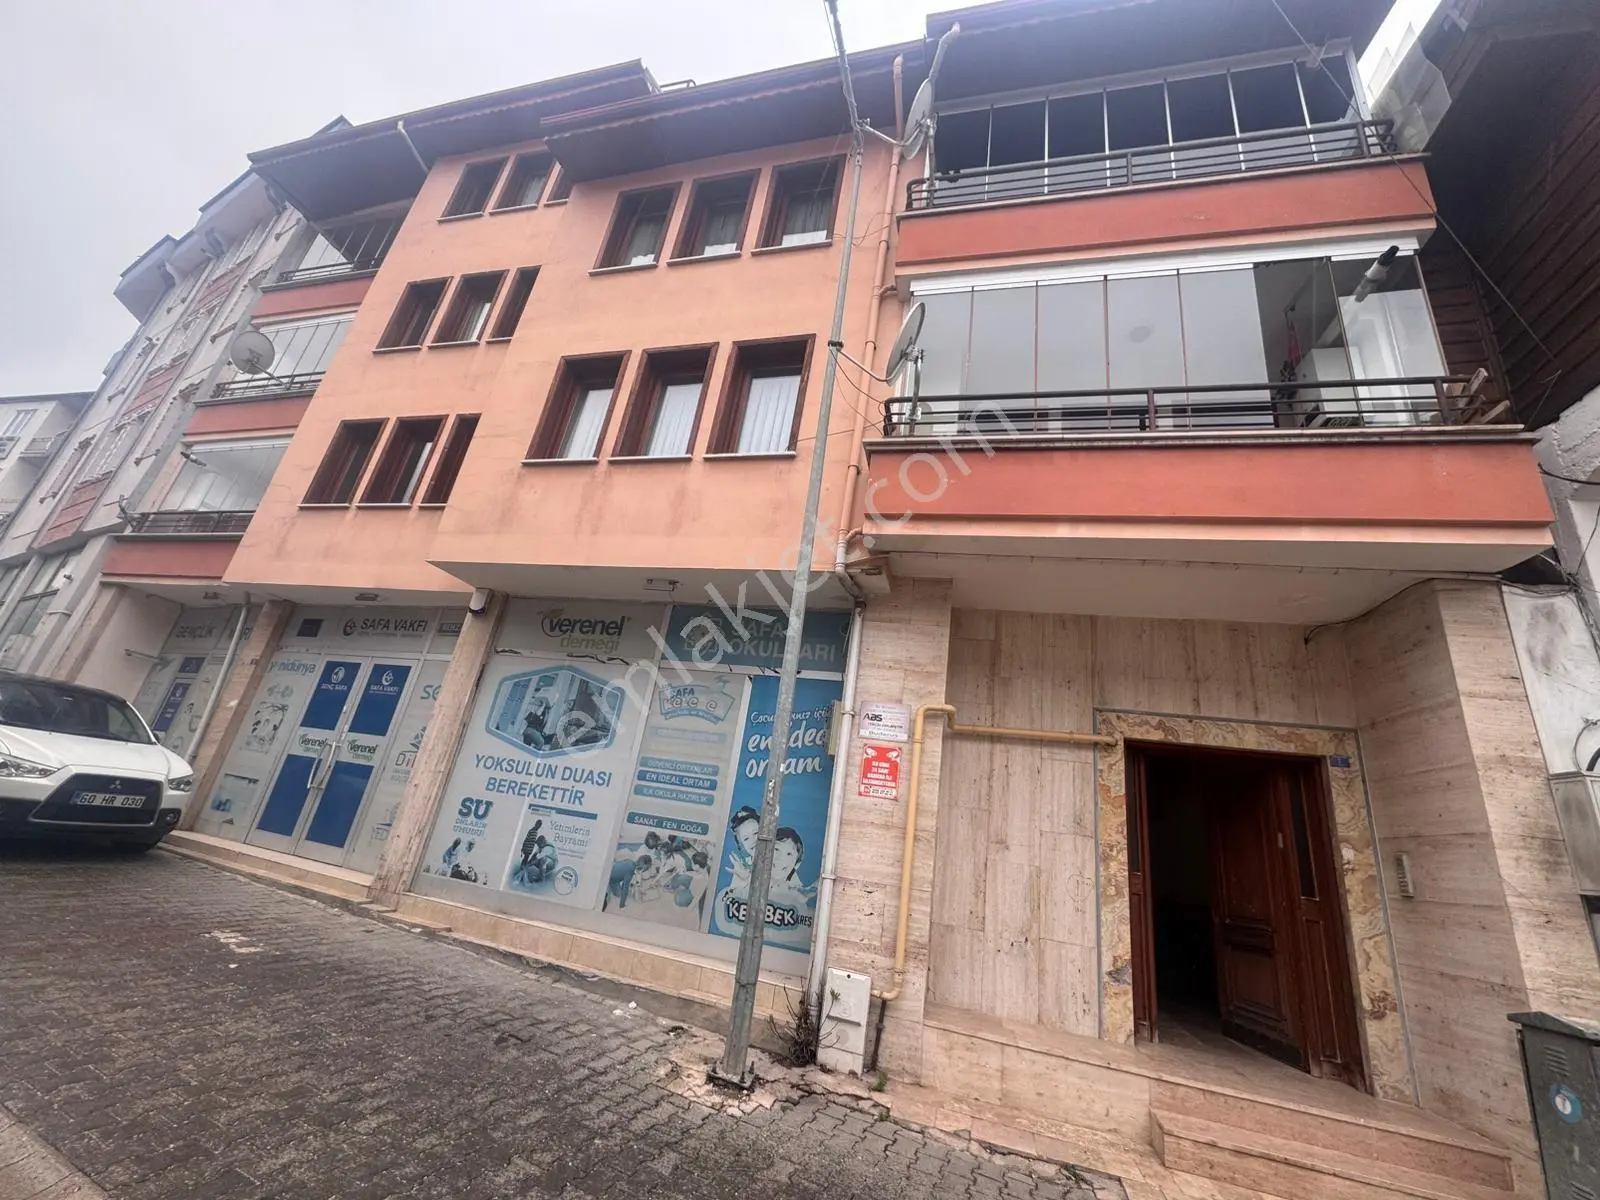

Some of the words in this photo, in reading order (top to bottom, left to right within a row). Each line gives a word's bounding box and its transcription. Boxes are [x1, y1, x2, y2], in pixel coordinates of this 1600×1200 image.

[360, 618, 390, 631] SAFA
[393, 619, 428, 633] VAKFI
[732, 636, 836, 662] OKULARI
[475, 754, 558, 780] YOKSULUN
[561, 766, 612, 788] DUASI
[745, 756, 823, 778] oram
[485, 777, 585, 806] BEREKETTİR
[646, 772, 657, 781] EN
[682, 777, 711, 788] ORTAM
[101, 795, 117, 805] HR
[458, 796, 494, 820] SU
[633, 815, 658, 826] SANAT
[661, 820, 678, 829] FEN
[680, 822, 703, 833] DOĞA
[728, 901, 796, 926] KEBEK
